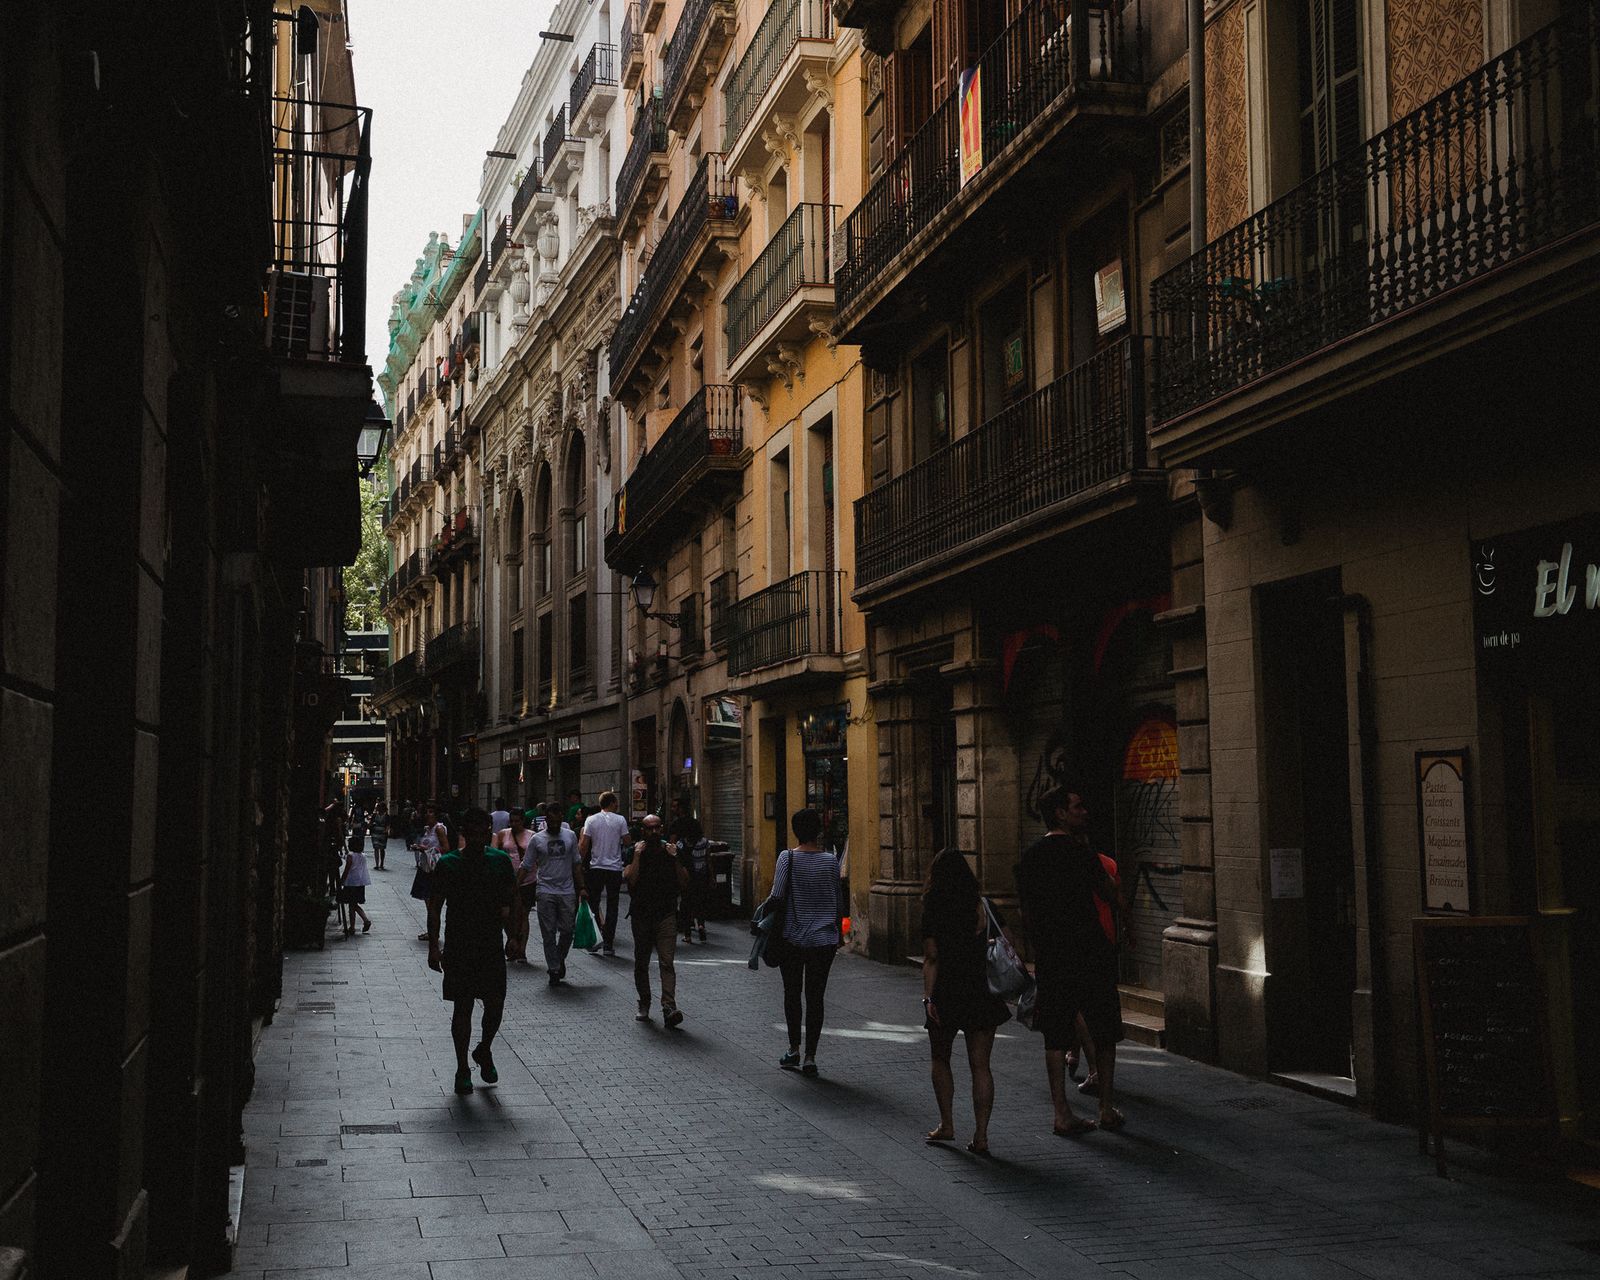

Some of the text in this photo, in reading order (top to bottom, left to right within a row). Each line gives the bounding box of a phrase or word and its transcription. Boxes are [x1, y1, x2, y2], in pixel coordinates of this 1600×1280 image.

[1533, 542, 1576, 618] El
[1500, 630, 1509, 645] de
[1511, 631, 1520, 648] pa
[1425, 782, 1447, 793] Pastes
[1425, 816, 1460, 827] Croissants
